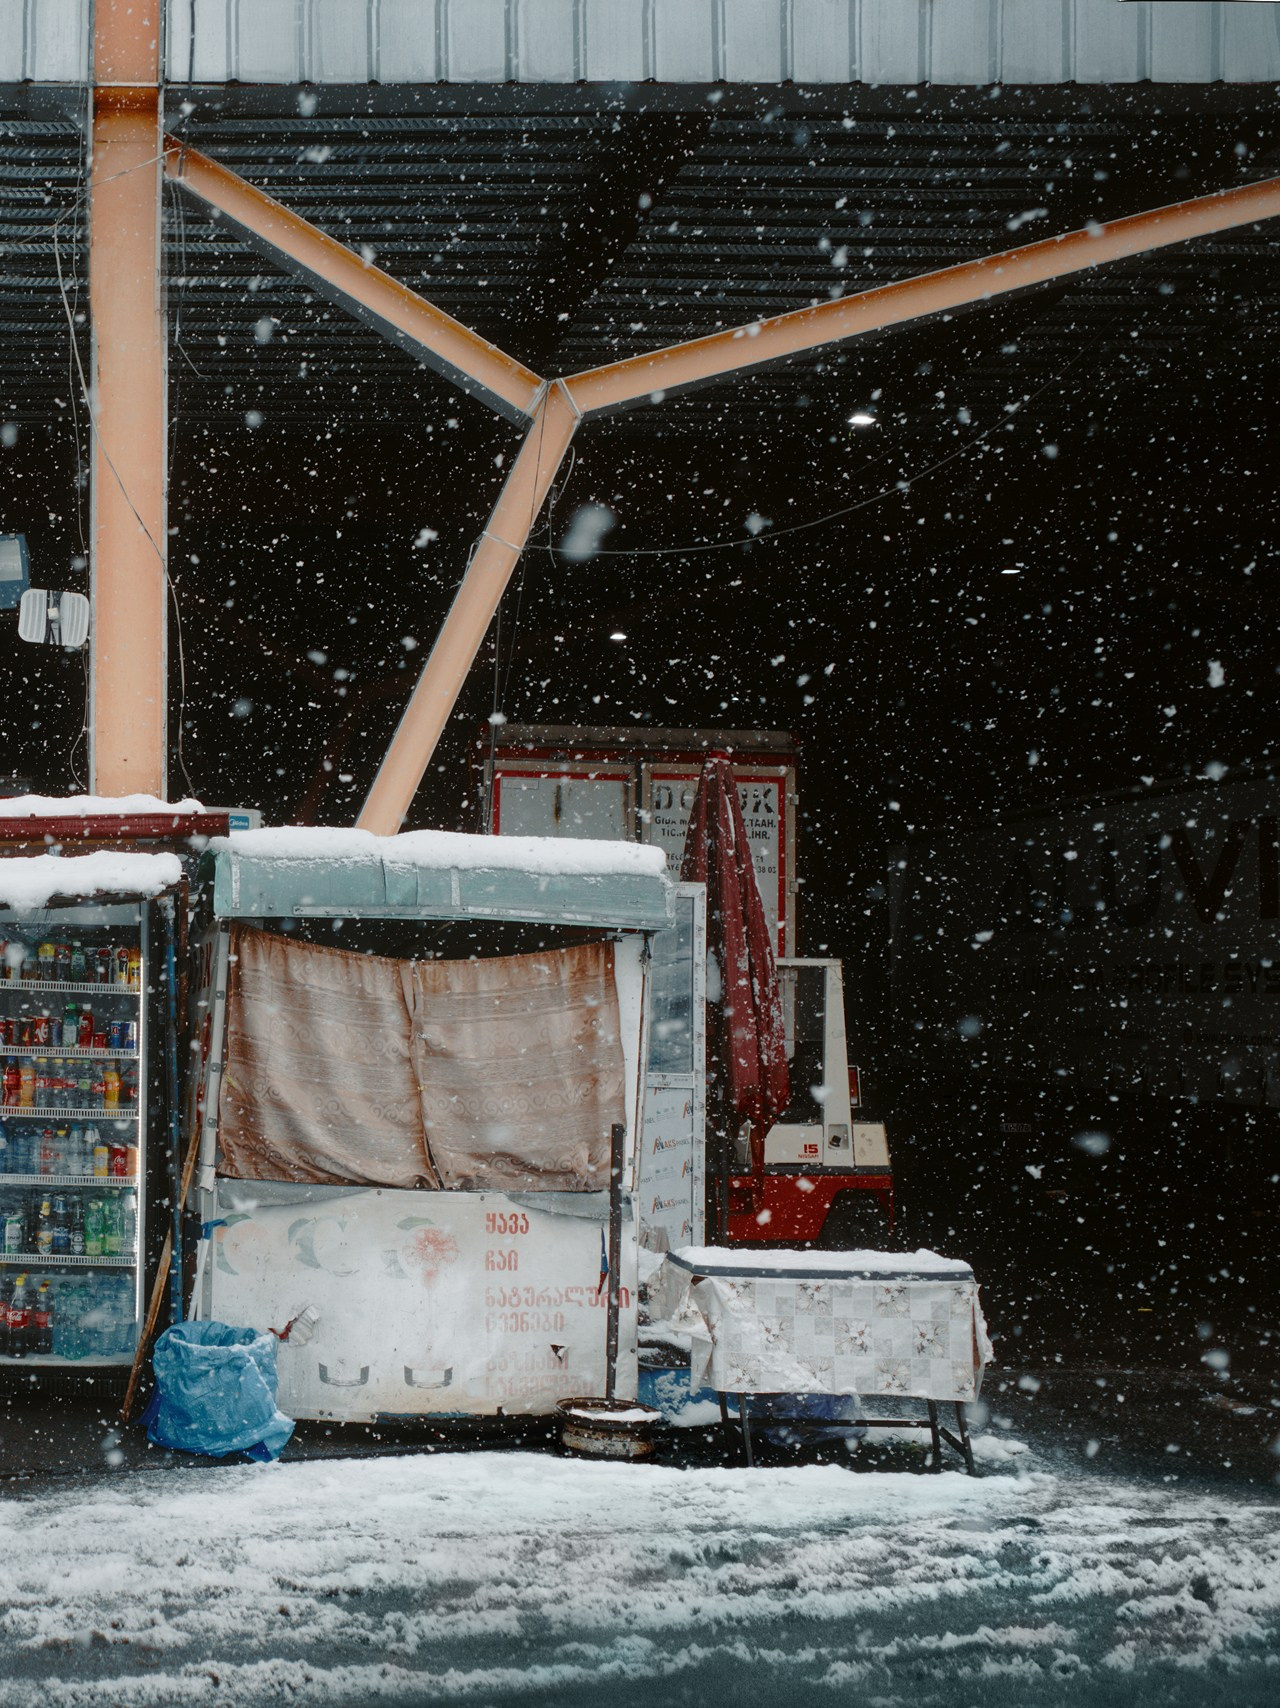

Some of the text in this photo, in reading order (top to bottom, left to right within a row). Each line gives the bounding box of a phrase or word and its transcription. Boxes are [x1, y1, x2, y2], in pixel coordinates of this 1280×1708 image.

[803, 1143, 819, 1154] 15
[485, 1213, 530, 1235] ყავა
[485, 1250, 518, 1271] ჩაი
[485, 1311, 565, 1334] წვენები
